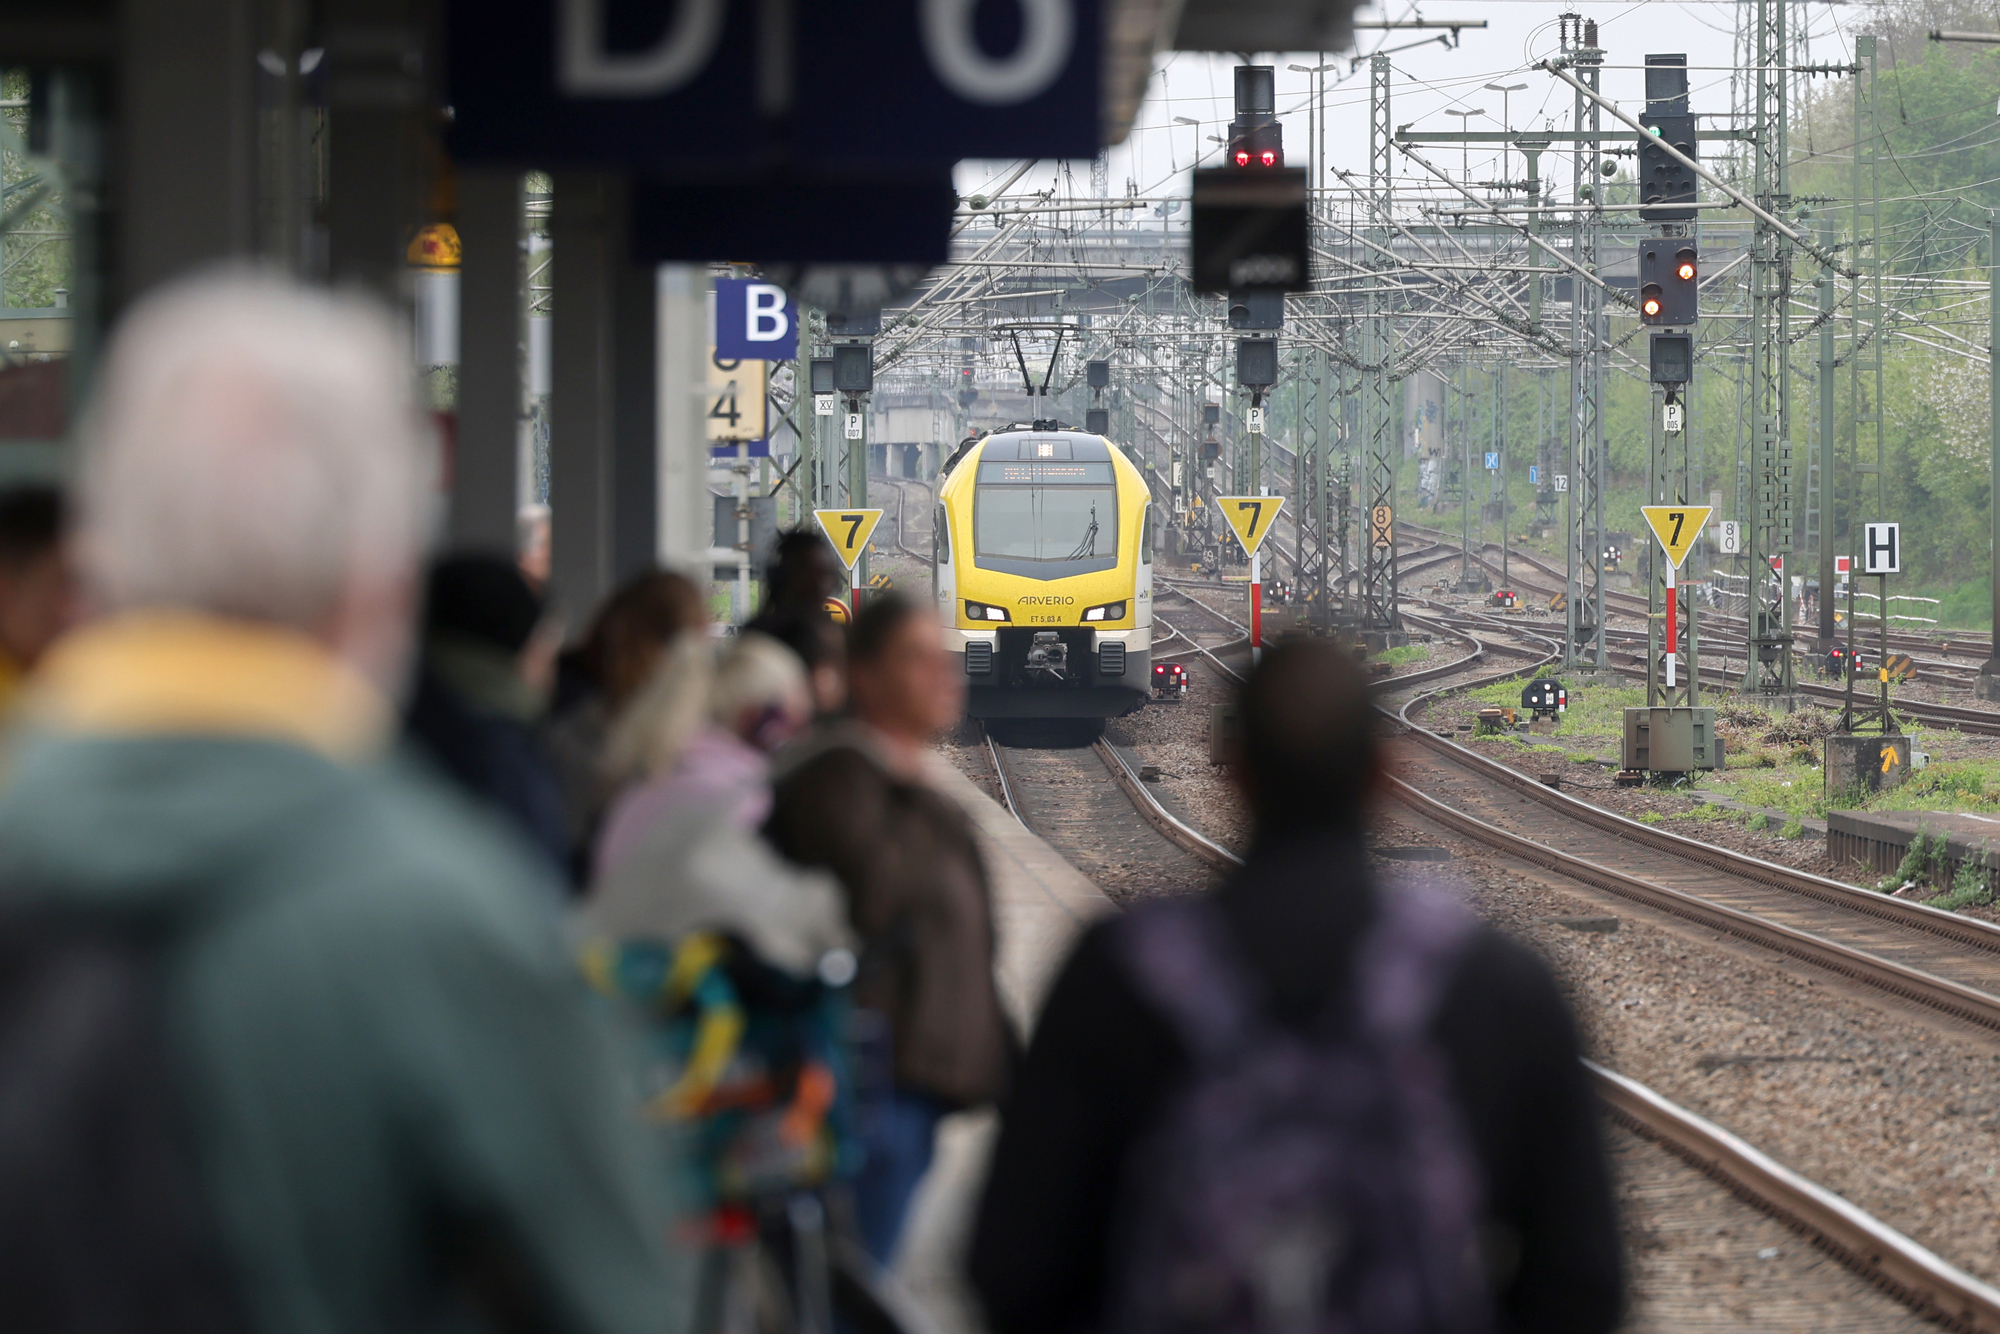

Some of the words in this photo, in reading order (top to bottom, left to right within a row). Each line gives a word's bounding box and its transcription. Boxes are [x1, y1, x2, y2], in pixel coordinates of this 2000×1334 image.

[746, 284, 789, 342] B
[709, 380, 741, 428] 4
[1251, 410, 1259, 422] P
[1668, 406, 1676, 420] P
[850, 415, 858, 428] P
[1249, 423, 1261, 432] 006
[1666, 420, 1679, 429] 005
[847, 429, 860, 438] 007
[1555, 477, 1567, 490] 12
[1238, 502, 1261, 538] 7
[1376, 508, 1386, 524] 8
[841, 515, 864, 549] 7
[1669, 513, 1685, 547] 7
[1725, 523, 1734, 536] 8
[1869, 527, 1896, 568] H
[1017, 596, 1075, 606] ARVERIO
[1030, 615, 1038, 623] ET
[1056, 615, 1062, 623] A
